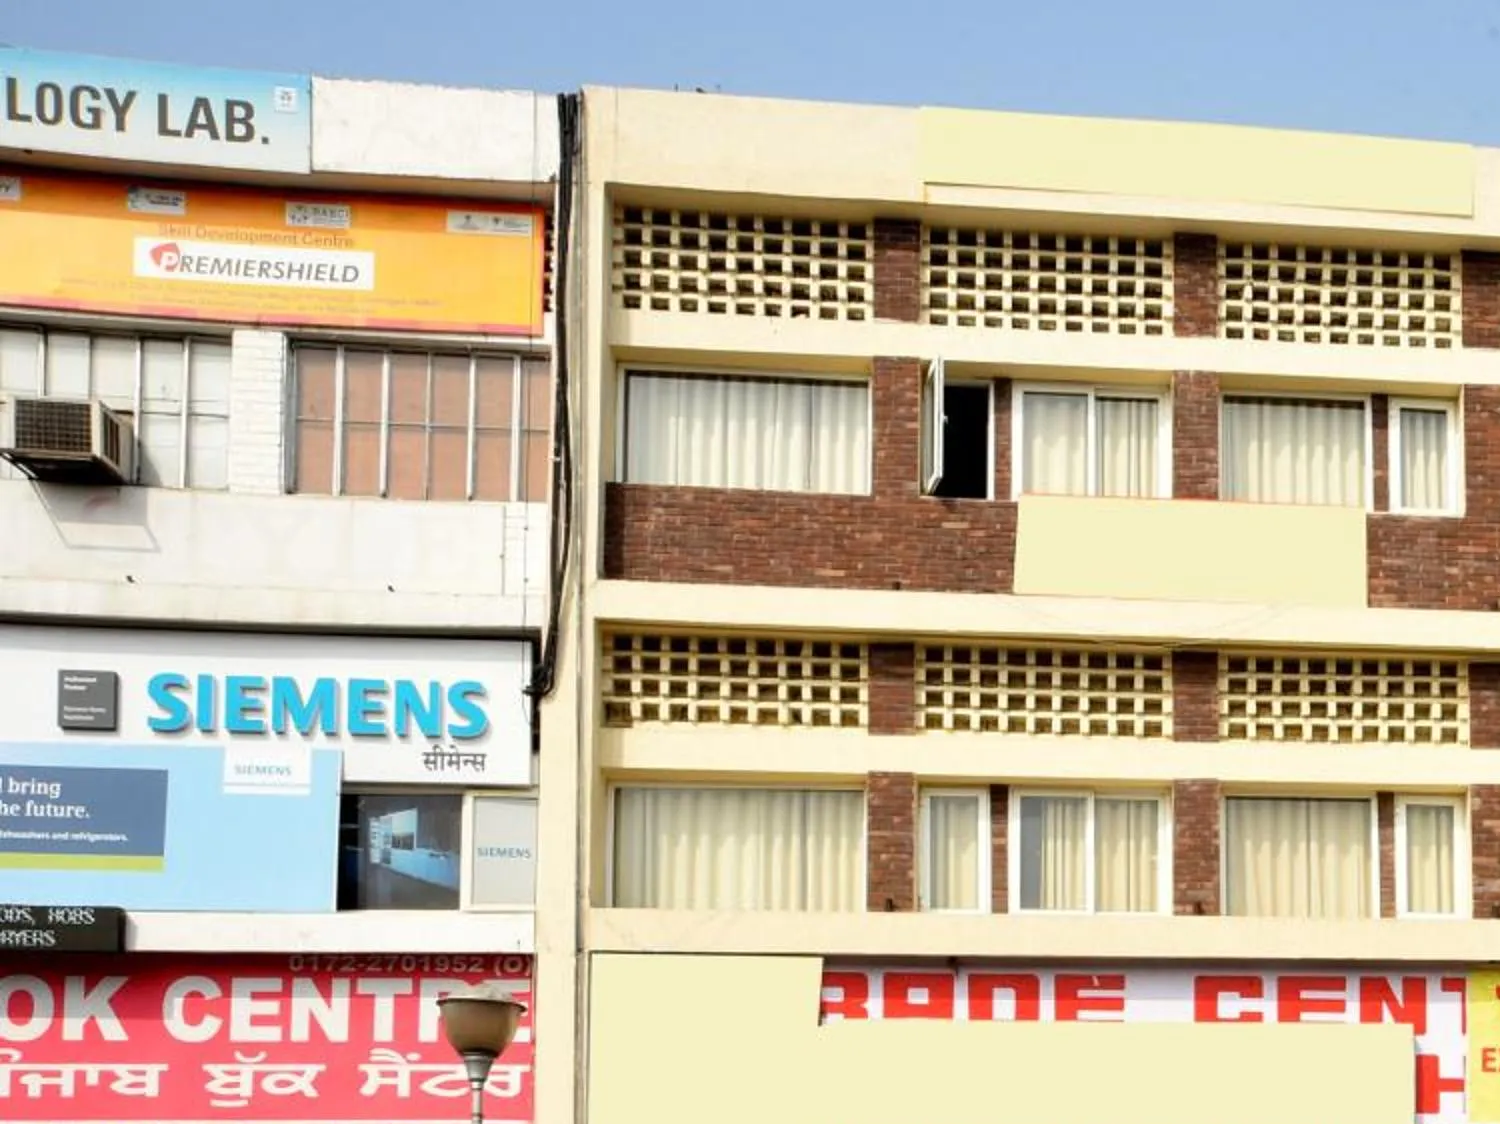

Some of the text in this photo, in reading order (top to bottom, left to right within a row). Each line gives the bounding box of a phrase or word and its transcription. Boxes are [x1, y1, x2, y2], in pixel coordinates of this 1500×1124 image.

[6, 77, 270, 144] LOGY LAB.
[195, 227, 297, 248] Development
[158, 250, 360, 283] PREMIERSHIELD
[147, 672, 490, 739] SIEMENS
[422, 744, 487, 771] सीमेन्स
[234, 764, 292, 776] SIEMENS
[8, 777, 61, 798] bring
[25, 800, 90, 818] future.
[477, 847, 531, 859] SIEMENS
[289, 956, 485, 973] 0172-2701952
[0, 974, 129, 1042] OK
